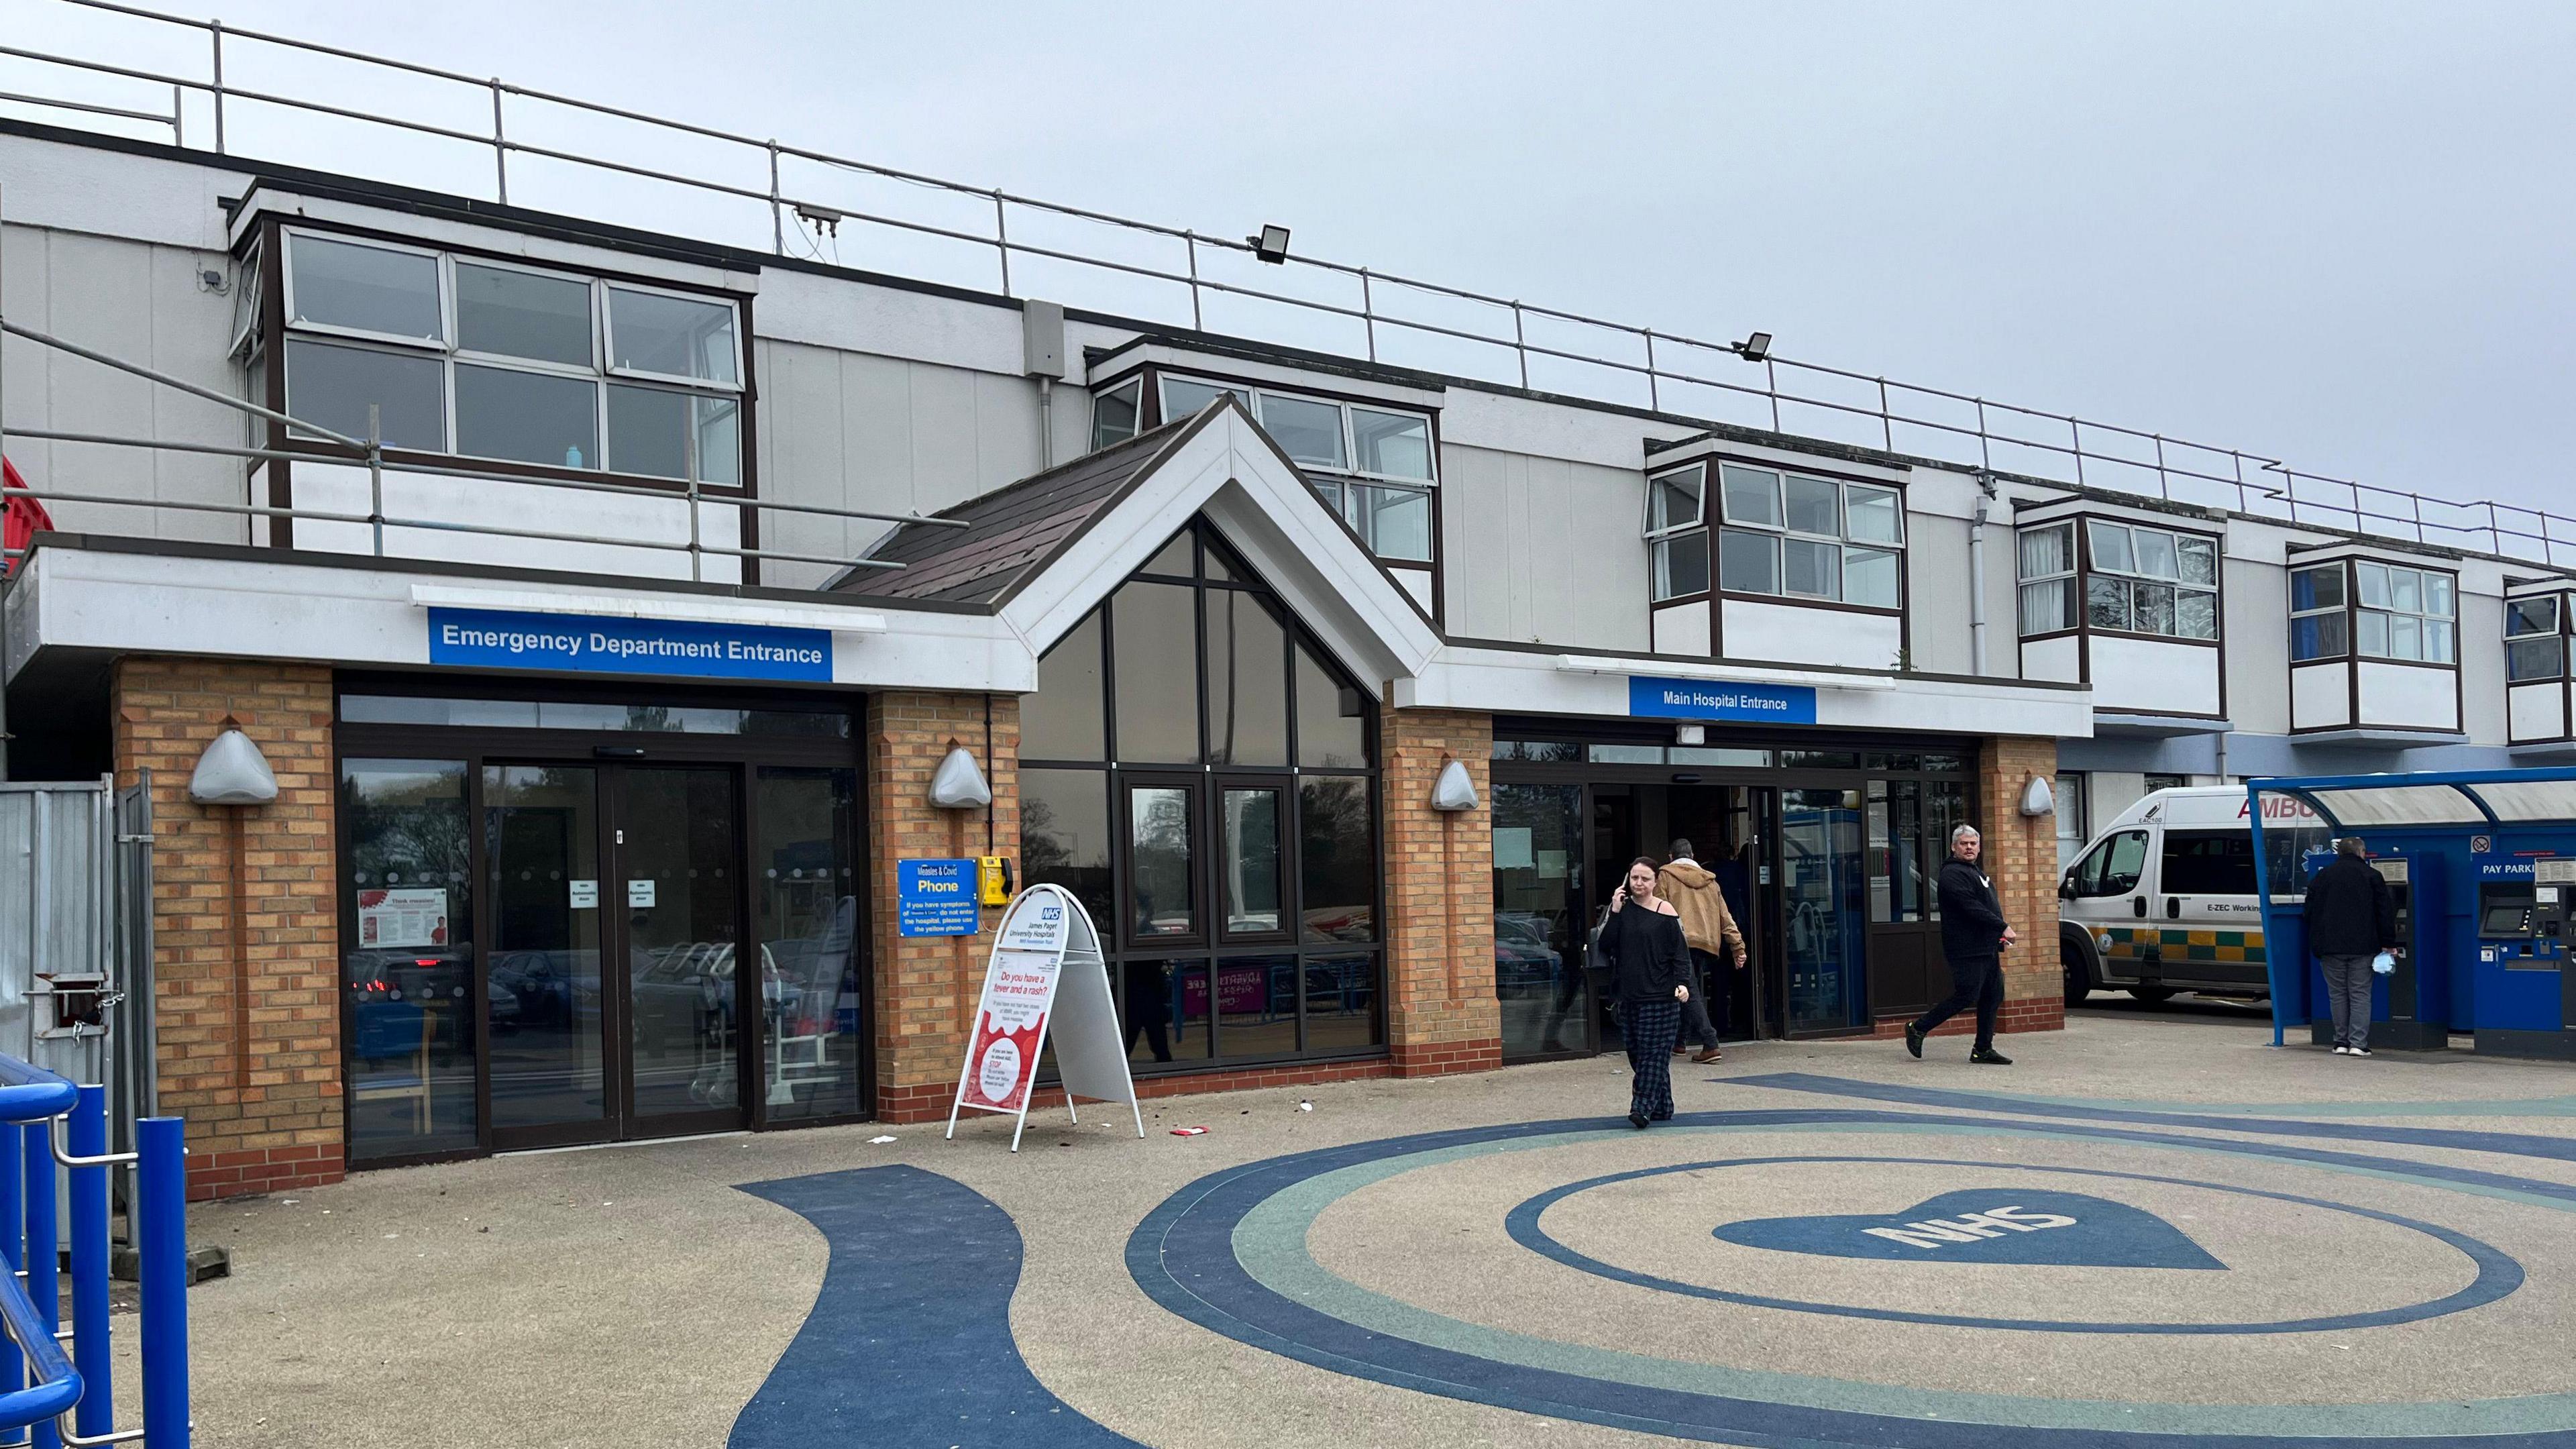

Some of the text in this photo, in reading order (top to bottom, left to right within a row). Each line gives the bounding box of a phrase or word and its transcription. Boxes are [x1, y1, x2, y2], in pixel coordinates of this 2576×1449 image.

[443, 624, 822, 664] Emergency Department Entrance
[1664, 690, 1787, 710] Main Hospital Entrance
[917, 865, 957, 876] Measles & Covid
[2483, 864, 2534, 874] PAY PARKI
[918, 879, 959, 892] Phone
[1042, 908, 1060, 920] NHS
[1043, 922, 1057, 930] Paget
[1010, 930, 1032, 938] University
[1001, 971, 1010, 980] Do
[1010, 974, 1023, 983] you
[1024, 973, 1039, 983] have
[994, 983, 1010, 993] fever
[1010, 985, 1022, 994] and
[1028, 987, 1048, 996] rash?
[1860, 1205, 2077, 1248] NHS
